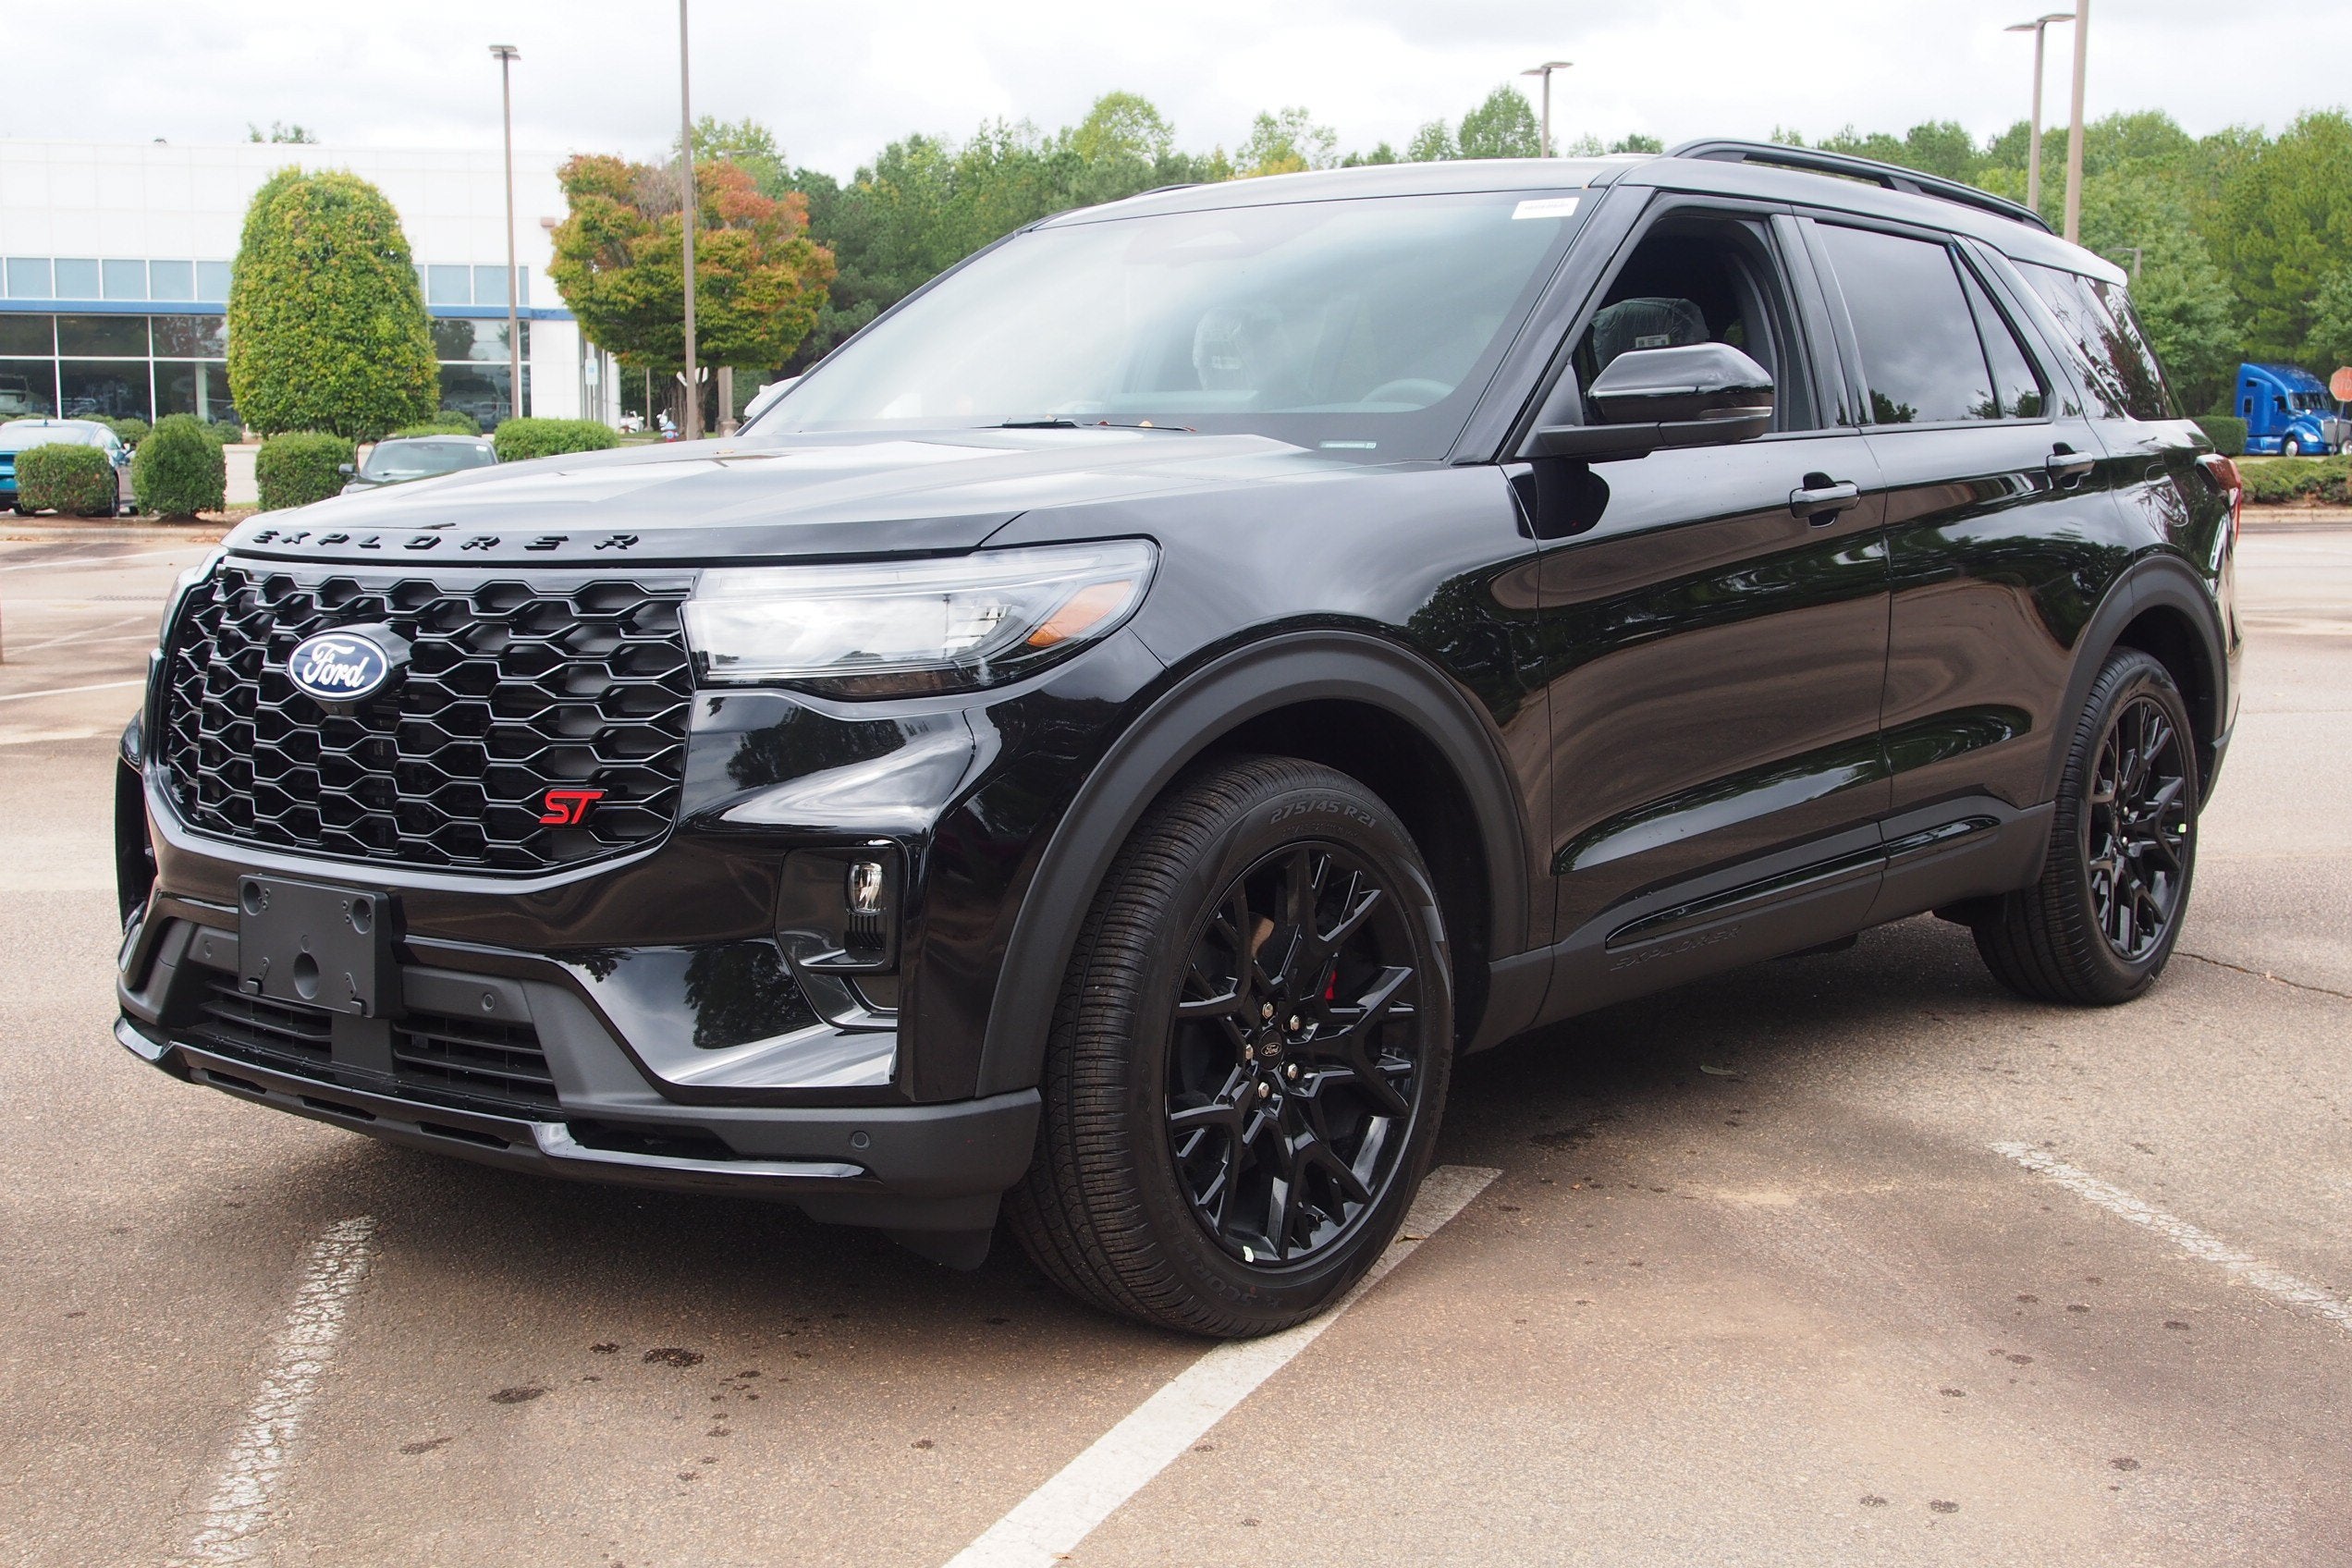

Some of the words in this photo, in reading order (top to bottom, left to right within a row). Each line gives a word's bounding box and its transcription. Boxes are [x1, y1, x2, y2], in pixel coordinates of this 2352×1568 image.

[251, 530, 641, 552] EXPLORER
[302, 642, 370, 688] Ford
[538, 789, 606, 825] ST
[1268, 799, 1341, 826] 275/45
